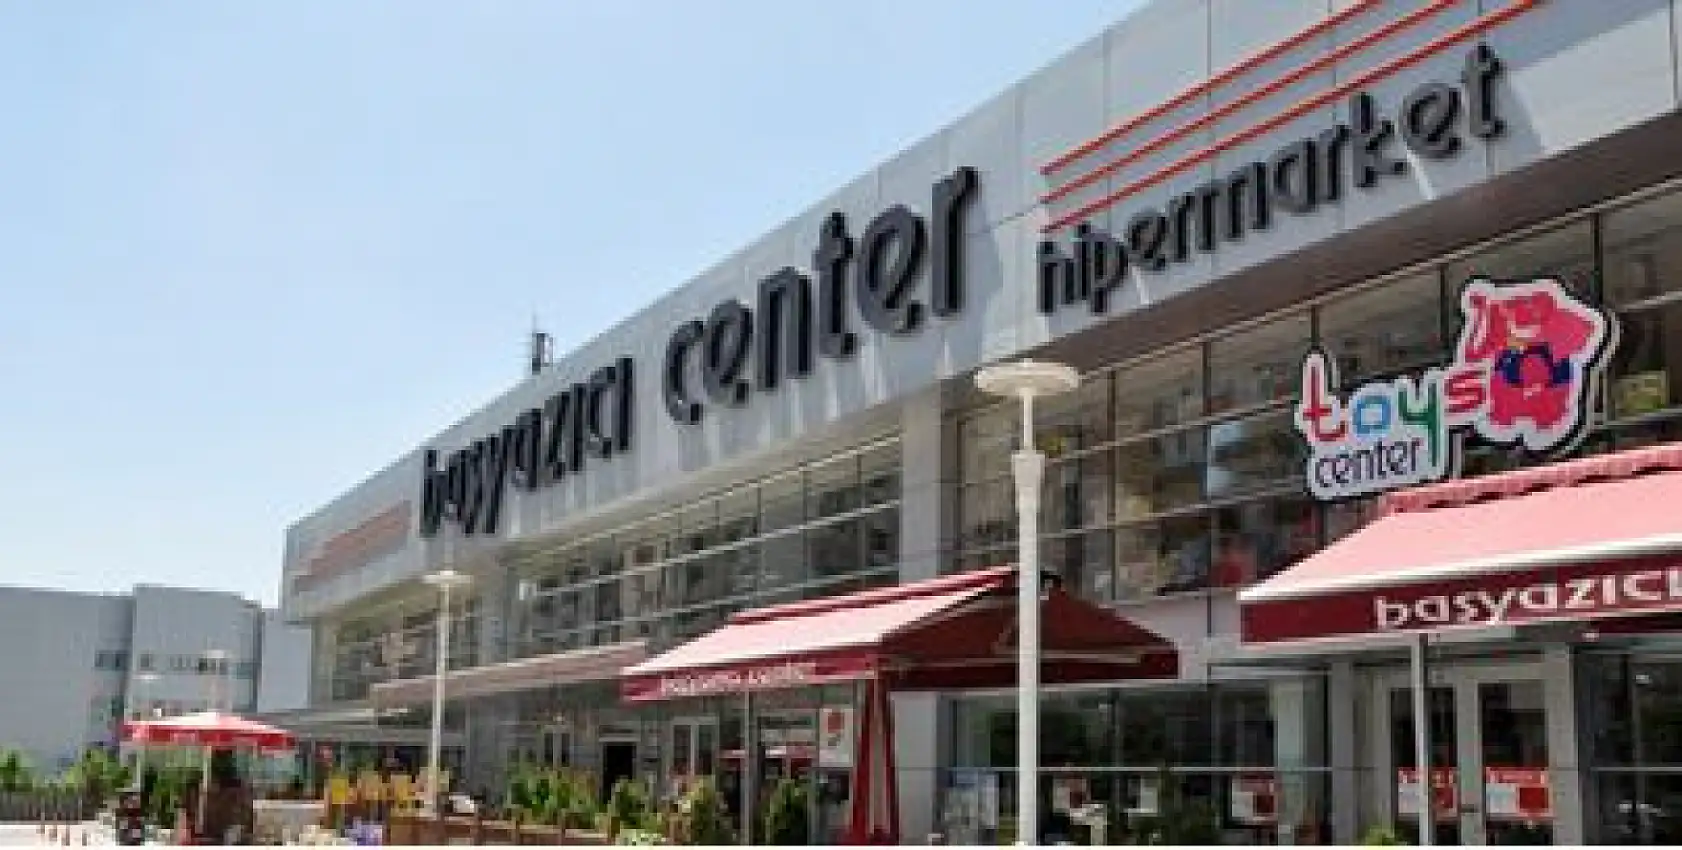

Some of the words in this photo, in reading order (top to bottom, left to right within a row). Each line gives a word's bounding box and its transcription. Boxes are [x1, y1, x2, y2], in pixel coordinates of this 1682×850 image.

[664, 165, 979, 424] center
[1303, 366, 1486, 467] toys
[1315, 436, 1424, 487] center
